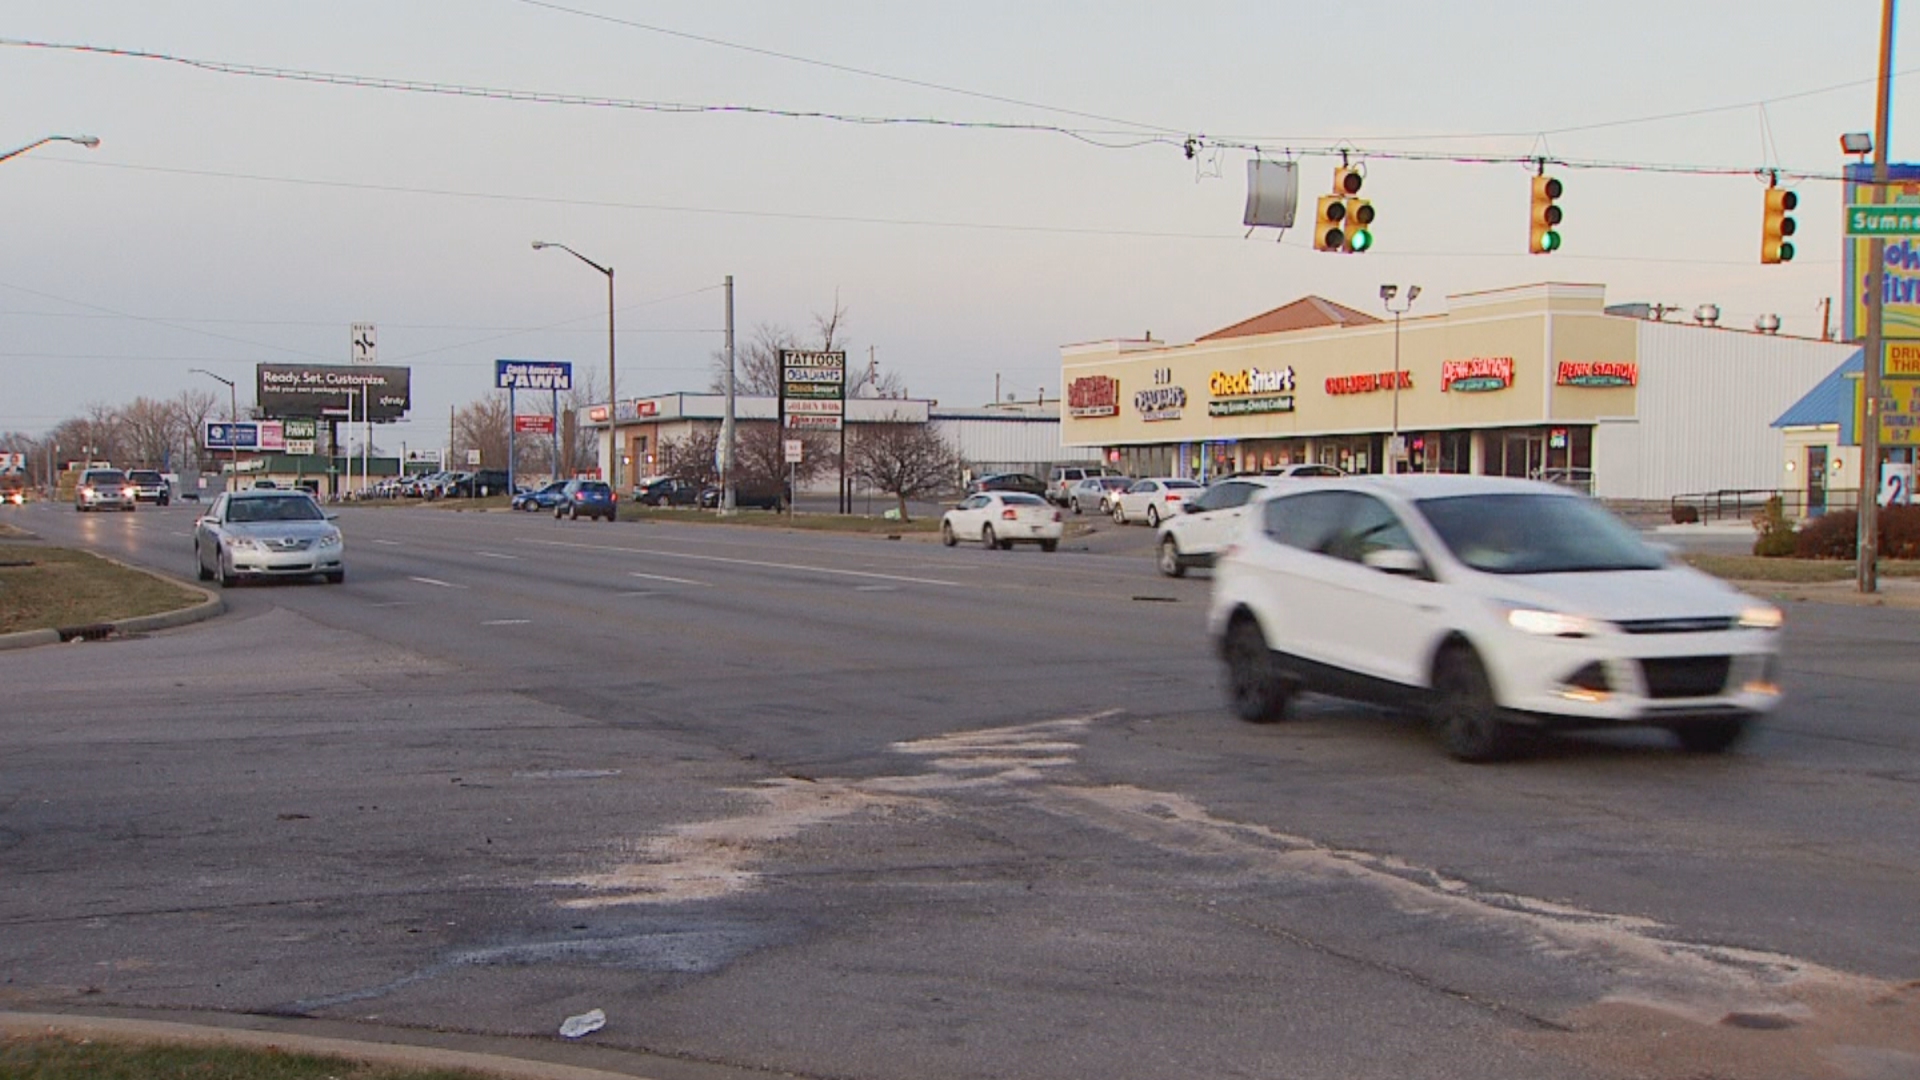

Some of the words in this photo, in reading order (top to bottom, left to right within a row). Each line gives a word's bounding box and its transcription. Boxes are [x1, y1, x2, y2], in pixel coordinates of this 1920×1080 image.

[786, 353, 843, 366] TATTOOS
[263, 371, 302, 386] Ready.
[303, 371, 325, 384] Set.
[326, 373, 388, 385] Customize.
[501, 374, 569, 389] PAWN
[1208, 366, 1294, 396] CheckSmart
[1441, 361, 1469, 391] PENN
[1470, 357, 1513, 387] STATION
[1557, 361, 1592, 386] PENN
[1592, 361, 1638, 386] STATION
[1325, 374, 1377, 395] GOLDEN
[285, 426, 314, 437] PAWN
